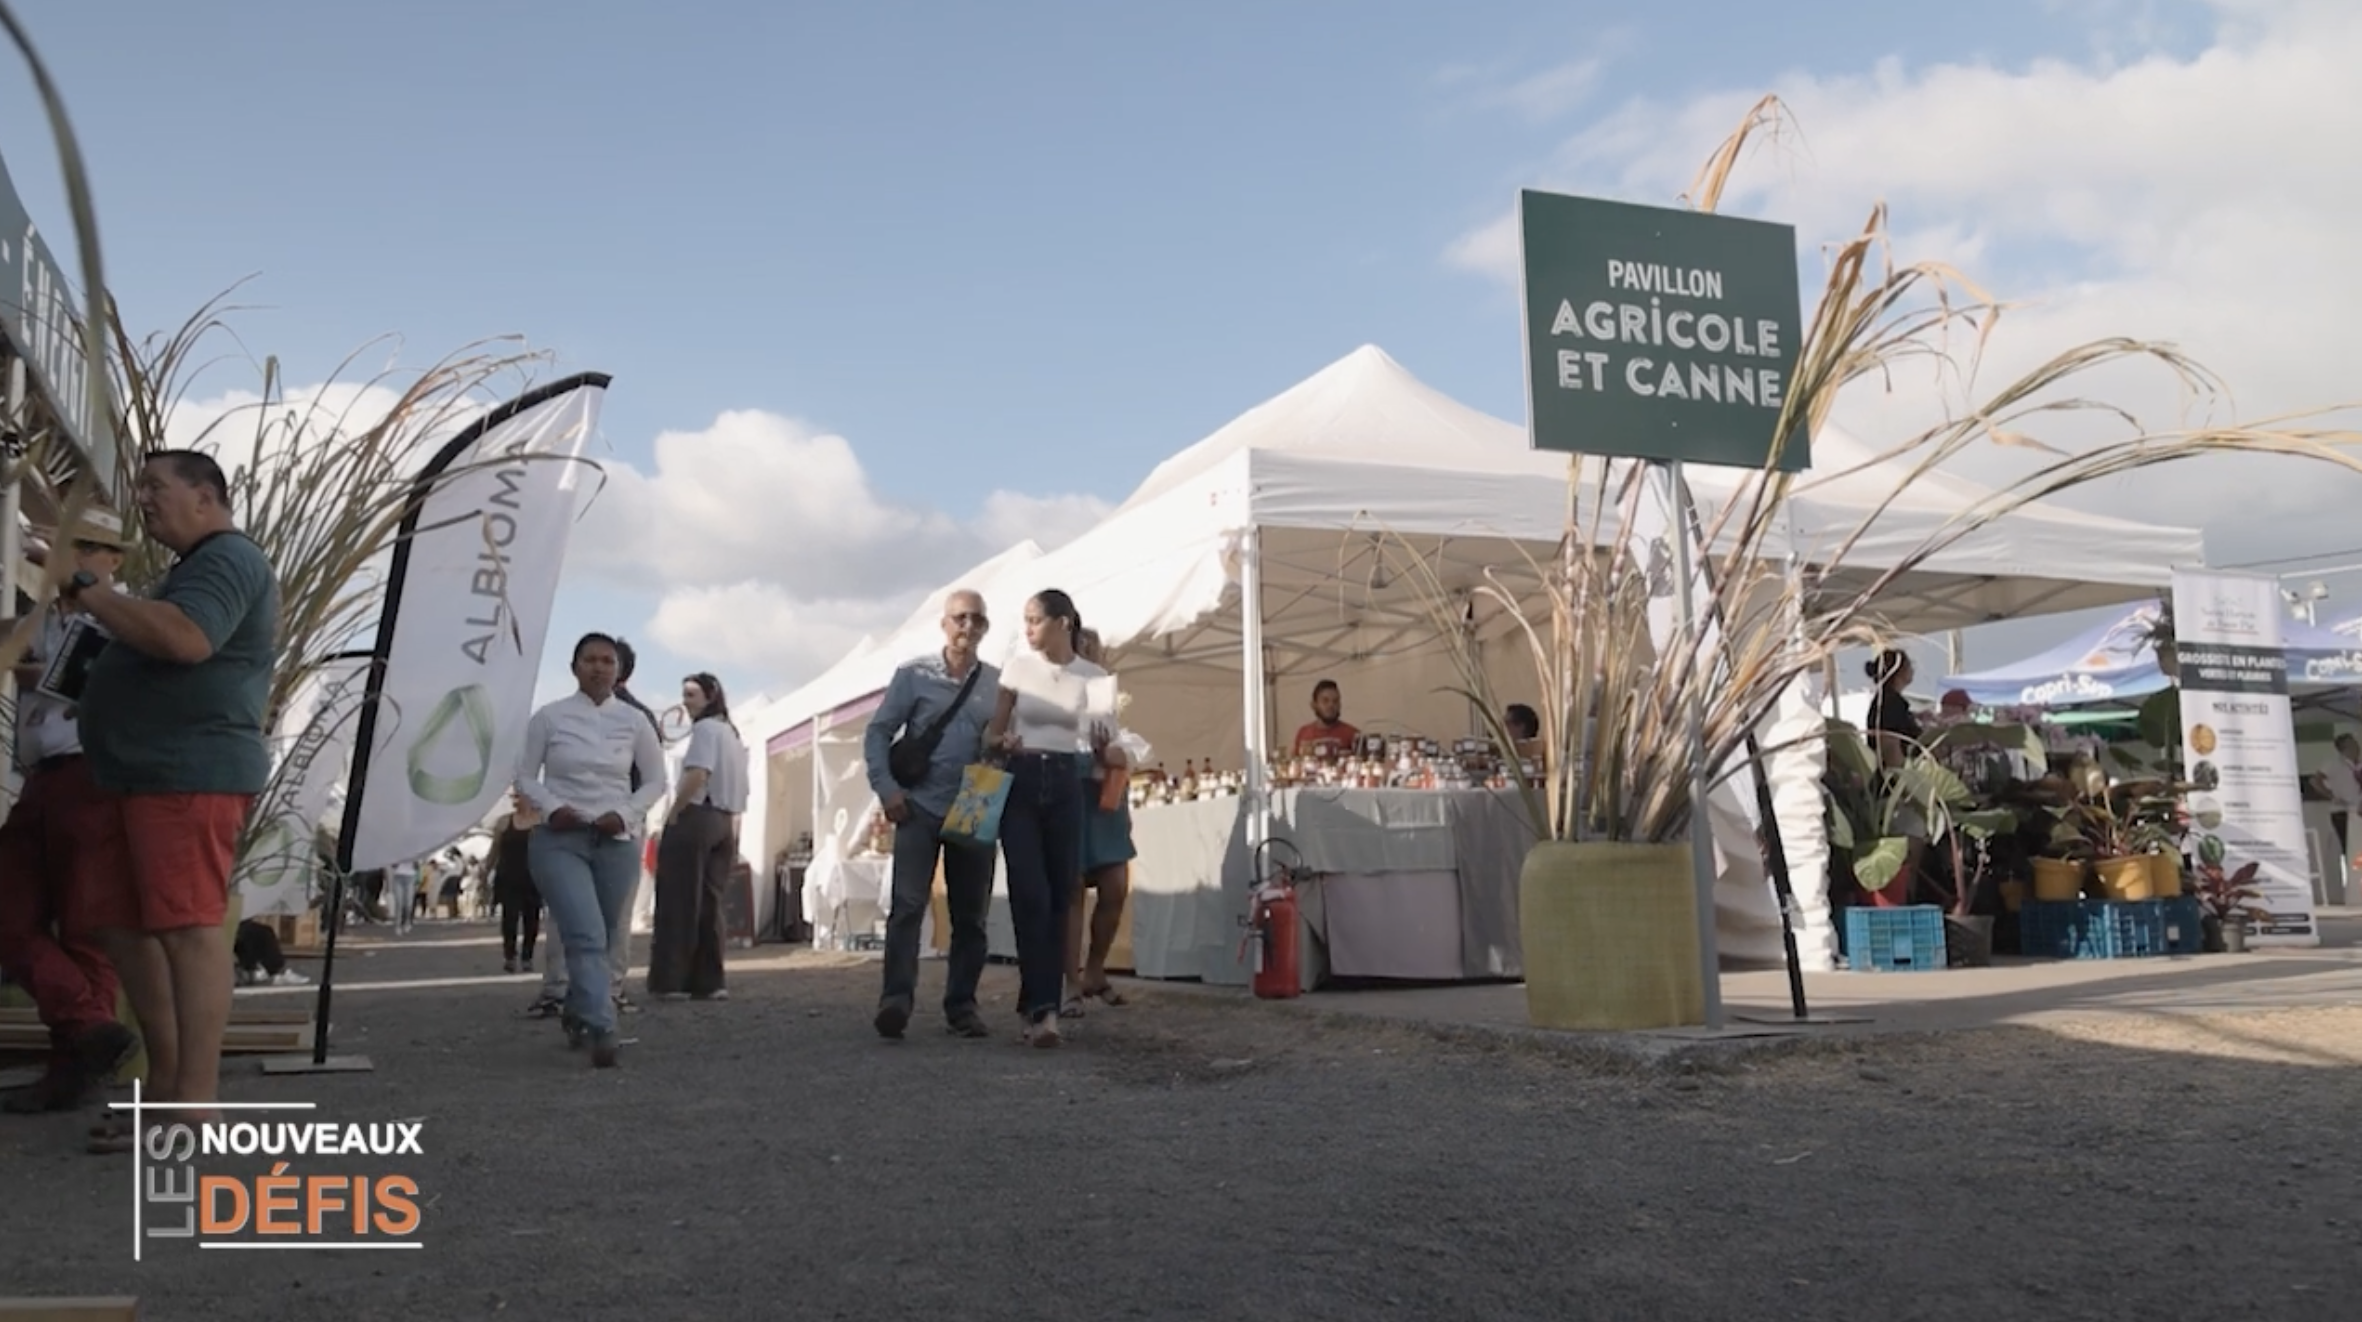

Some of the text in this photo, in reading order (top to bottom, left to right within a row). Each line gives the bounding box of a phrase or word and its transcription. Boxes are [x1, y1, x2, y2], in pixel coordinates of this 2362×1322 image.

[1607, 259, 1723, 300] PAVILLON
[1557, 349, 1782, 408] ET CANNE
[461, 438, 531, 666] ALBIOMA
